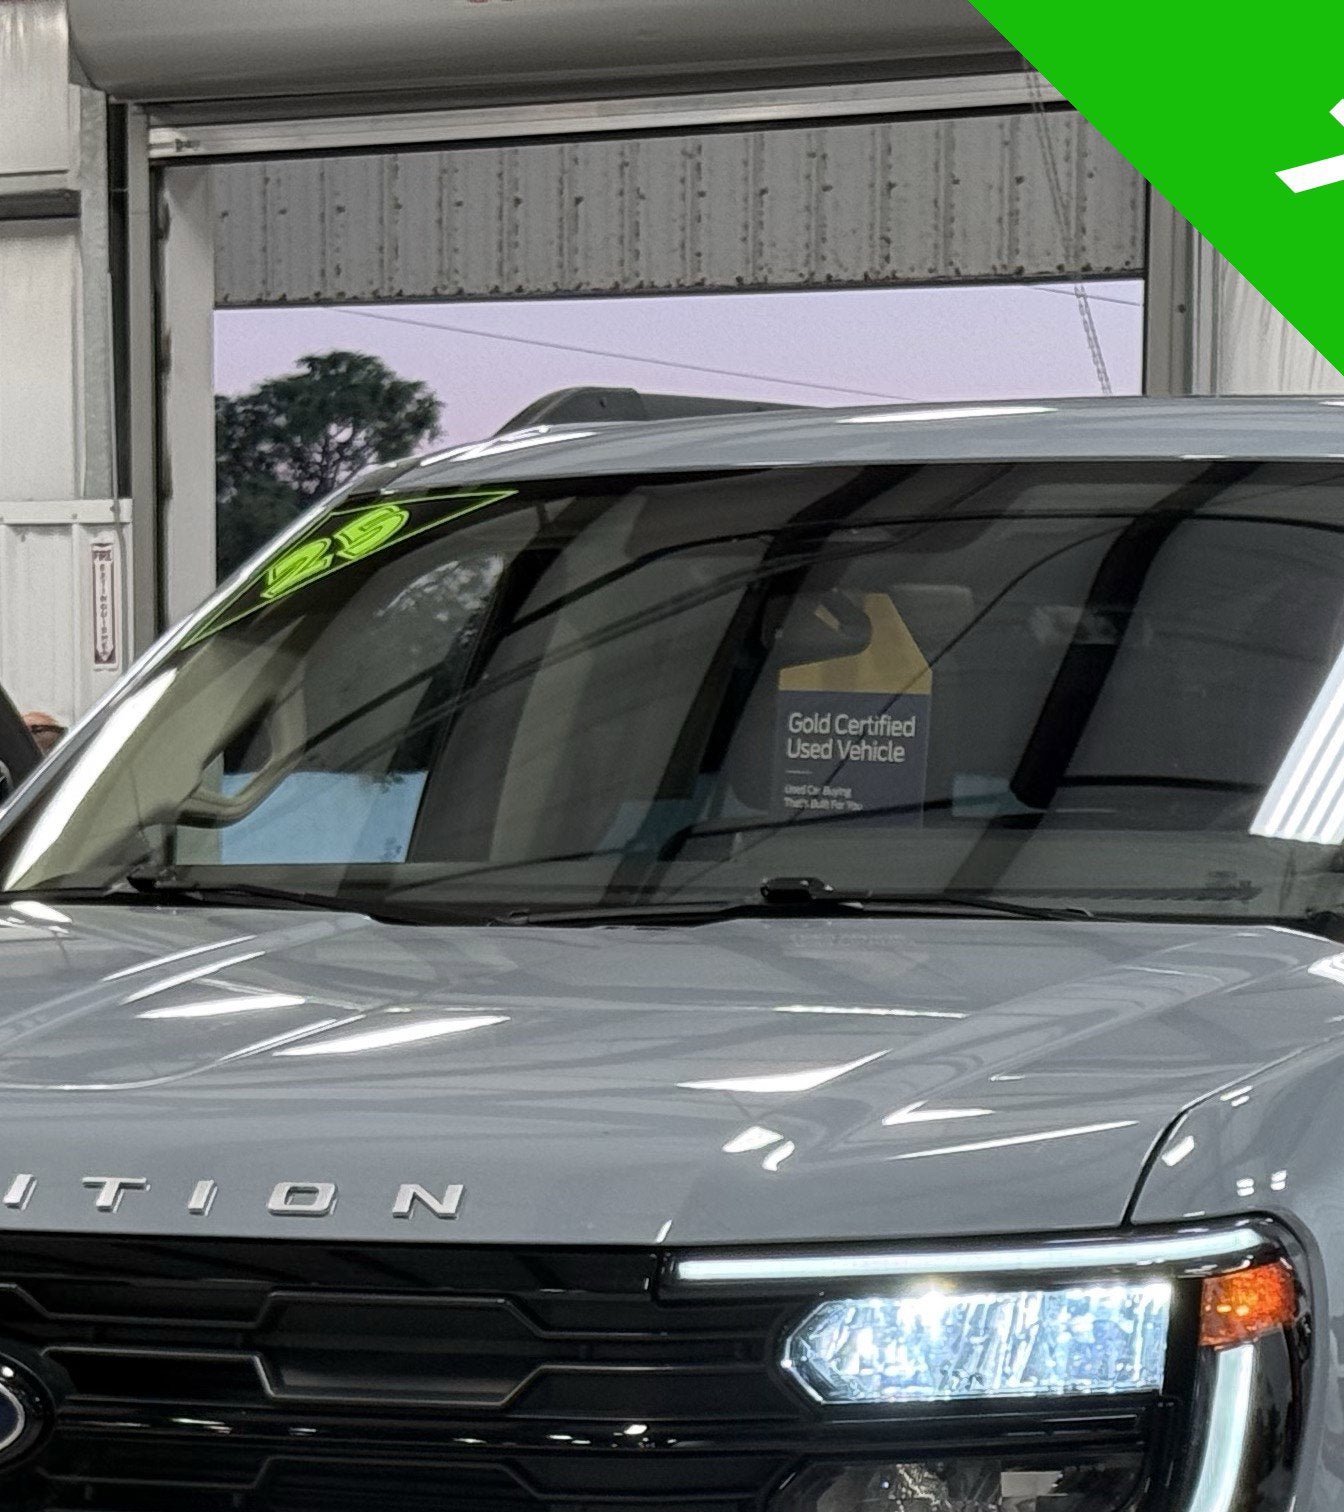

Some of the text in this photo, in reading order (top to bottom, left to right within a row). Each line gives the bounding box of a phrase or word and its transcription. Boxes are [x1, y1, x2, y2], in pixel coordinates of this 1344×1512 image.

[260, 505, 410, 599] 25
[788, 712, 916, 737] Gold Certified
[787, 738, 906, 763] Used Vehicle
